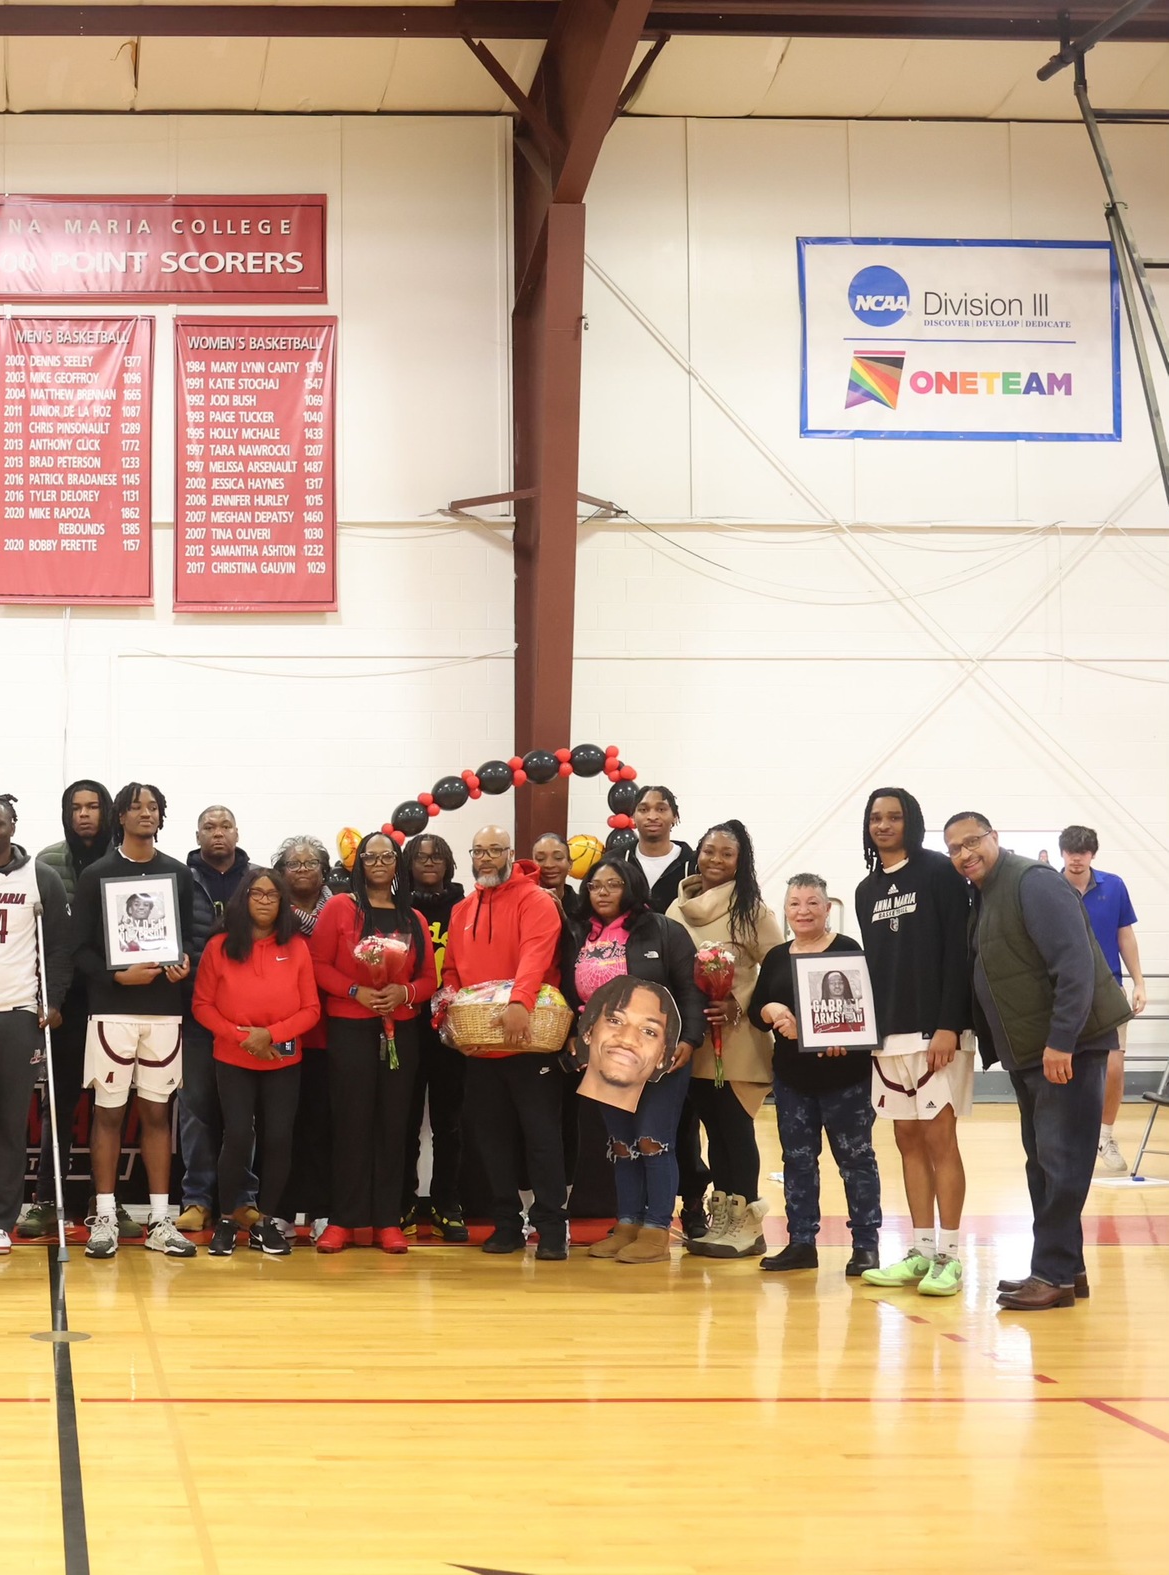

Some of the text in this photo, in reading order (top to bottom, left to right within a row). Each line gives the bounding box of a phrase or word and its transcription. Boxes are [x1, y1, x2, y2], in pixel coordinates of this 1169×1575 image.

[64, 218, 153, 235] MARIA
[170, 218, 292, 236] COLLEGE
[51, 251, 148, 274] POINT
[160, 251, 305, 274] SCORERS
[854, 295, 909, 312] NCAA
[923, 291, 1049, 317] Division III
[923, 319, 1072, 329] DISCOVER DEVELOP DEDICATE
[17, 330, 130, 345] MEN'S BASKETBALL
[187, 336, 323, 350] WOMEN'S BASKETBALL
[5, 372, 142, 384] 2003 MIKE GEOFFROY 1096
[909, 370, 1073, 396] ONETEAM
[186, 428, 323, 440] 1995 HOLLY MCHALE 1433
[4, 456, 140, 469] 2013 BRAD PETERSON 1233
[185, 478, 324, 490] 2002 JESSICA HAYNES 1317
[4, 490, 140, 502] 2016 TYLER DELOREY 1131
[185, 494, 324, 507] 2006 JENNIFER HURLEY 1015
[4, 507, 140, 519] 2020 MIKE RAPOZA 1862
[58, 523, 140, 535] REBOUNDS 1385
[185, 528, 324, 540] 2007 TINA OLIVERI 1030
[4, 539, 140, 551] 2020 BOBBY PERETTE 1157
[185, 545, 324, 557] 2012 SAMANTHA ASHTON 1232
[186, 562, 326, 574] 2017 CHRISTINA GAUVIN 1029
[872, 897, 892, 914] ANNA
[893, 891, 916, 908] MARIA
[105, 1071, 115, 1084] A
